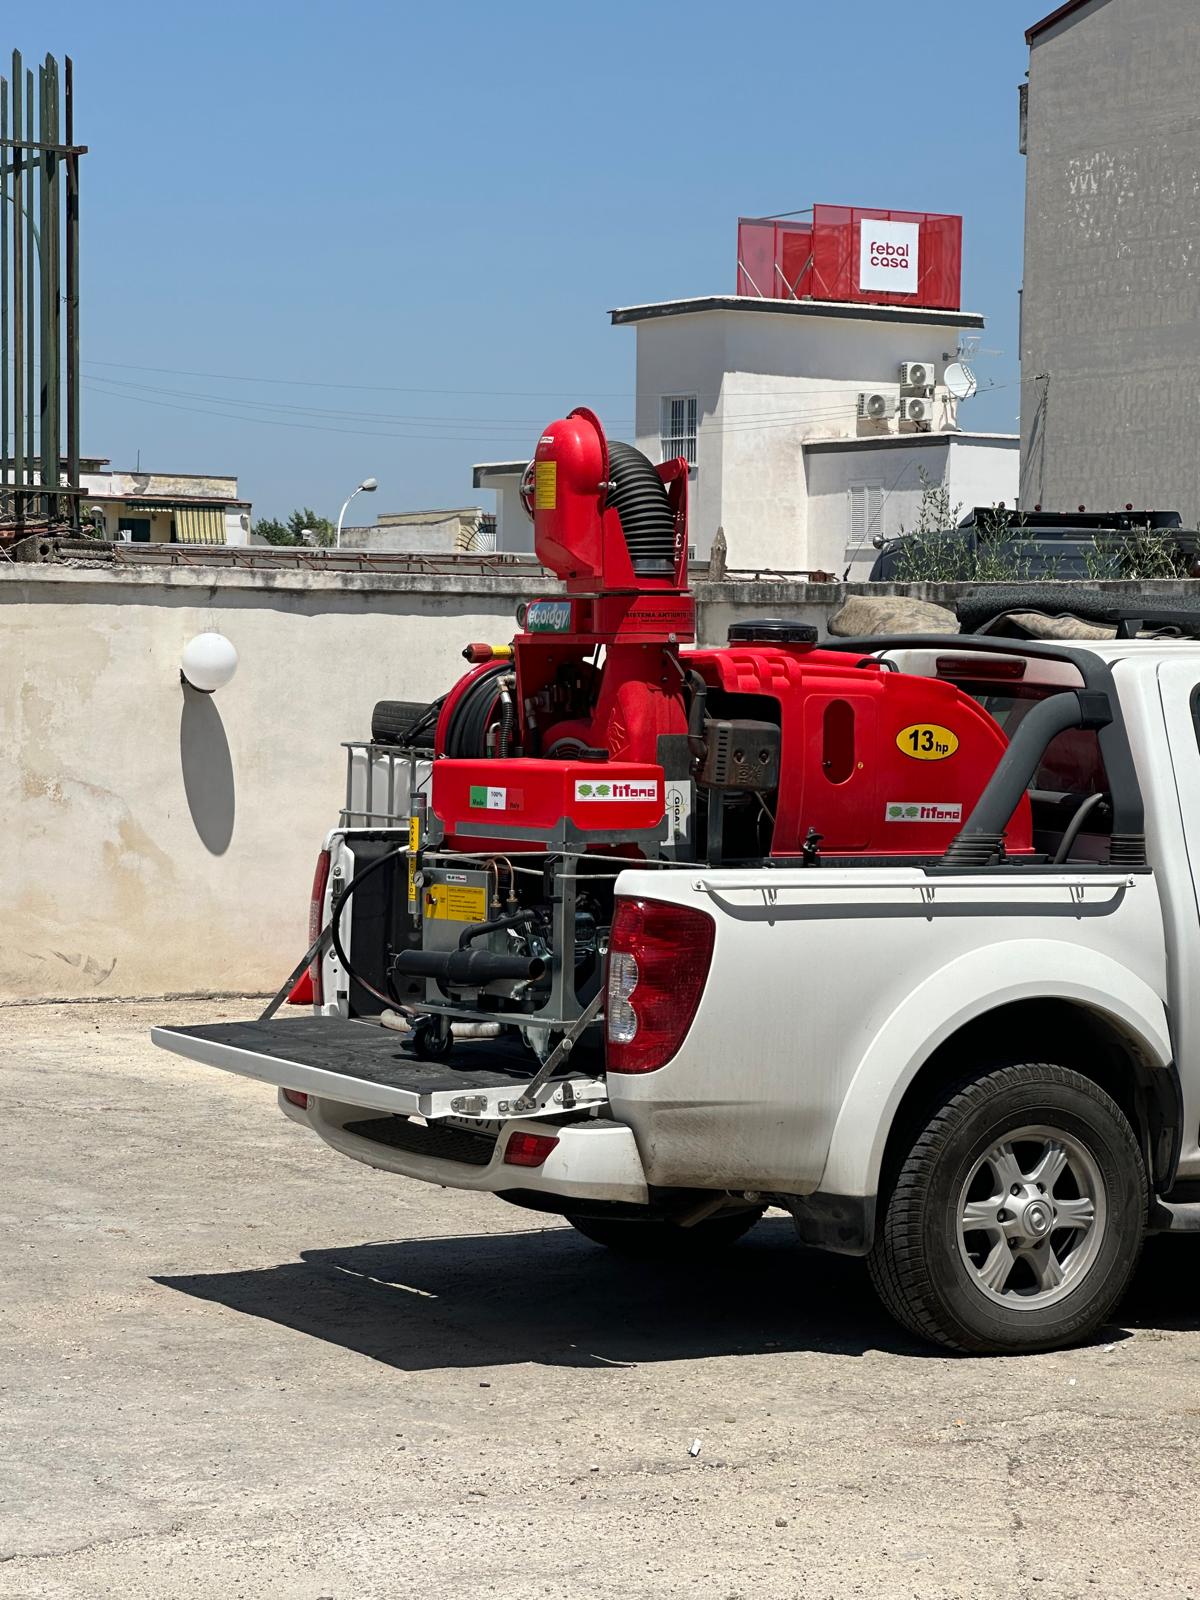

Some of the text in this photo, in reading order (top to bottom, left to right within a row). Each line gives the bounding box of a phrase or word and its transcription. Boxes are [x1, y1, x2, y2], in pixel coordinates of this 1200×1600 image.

[871, 242, 909, 257] febal
[871, 256, 909, 269] casa
[909, 729, 949, 754] 13 hp
[612, 784, 656, 797] tifone
[920, 806, 960, 819] tifone
